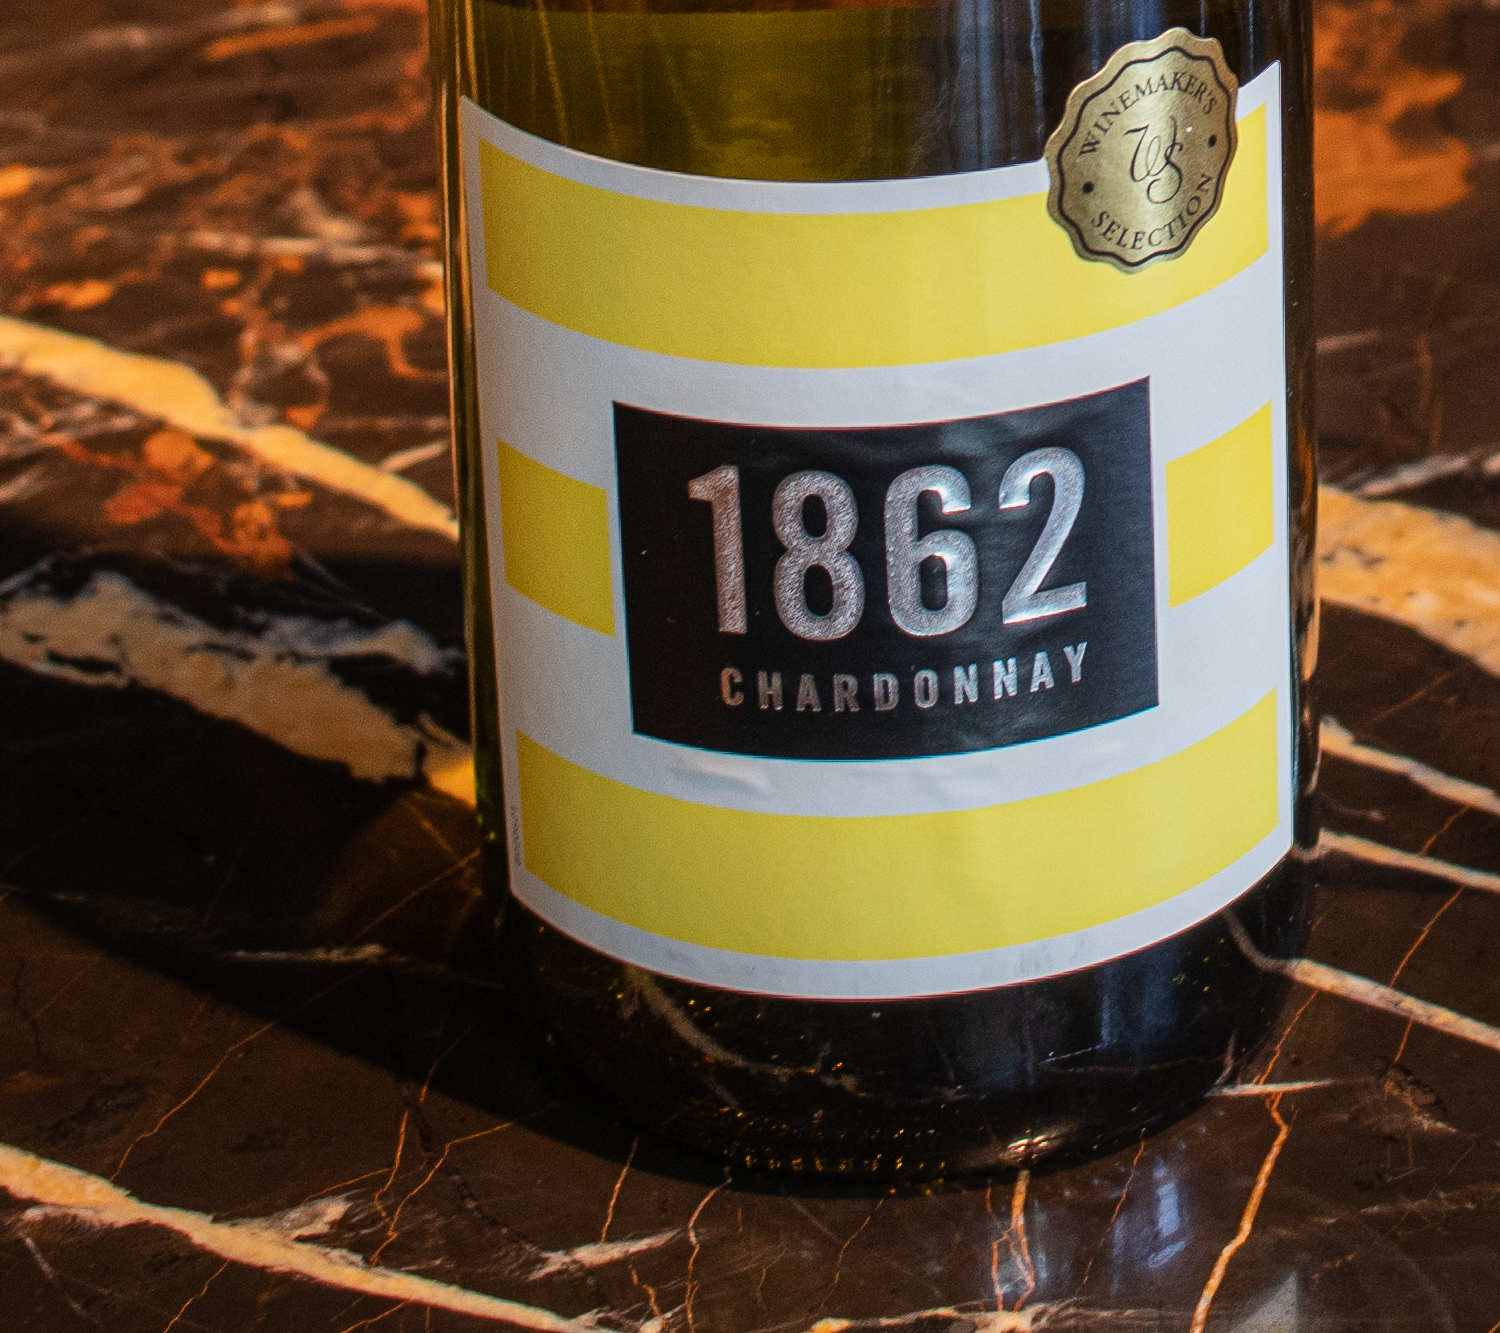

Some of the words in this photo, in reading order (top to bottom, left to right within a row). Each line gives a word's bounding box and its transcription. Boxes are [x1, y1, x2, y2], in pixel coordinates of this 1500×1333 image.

[1079, 71, 1217, 157] WINEMAKER'S
[1091, 173, 1213, 250] SELECTION
[687, 446, 1088, 642] 1862
[719, 641, 1089, 713] CHARDONNAY
